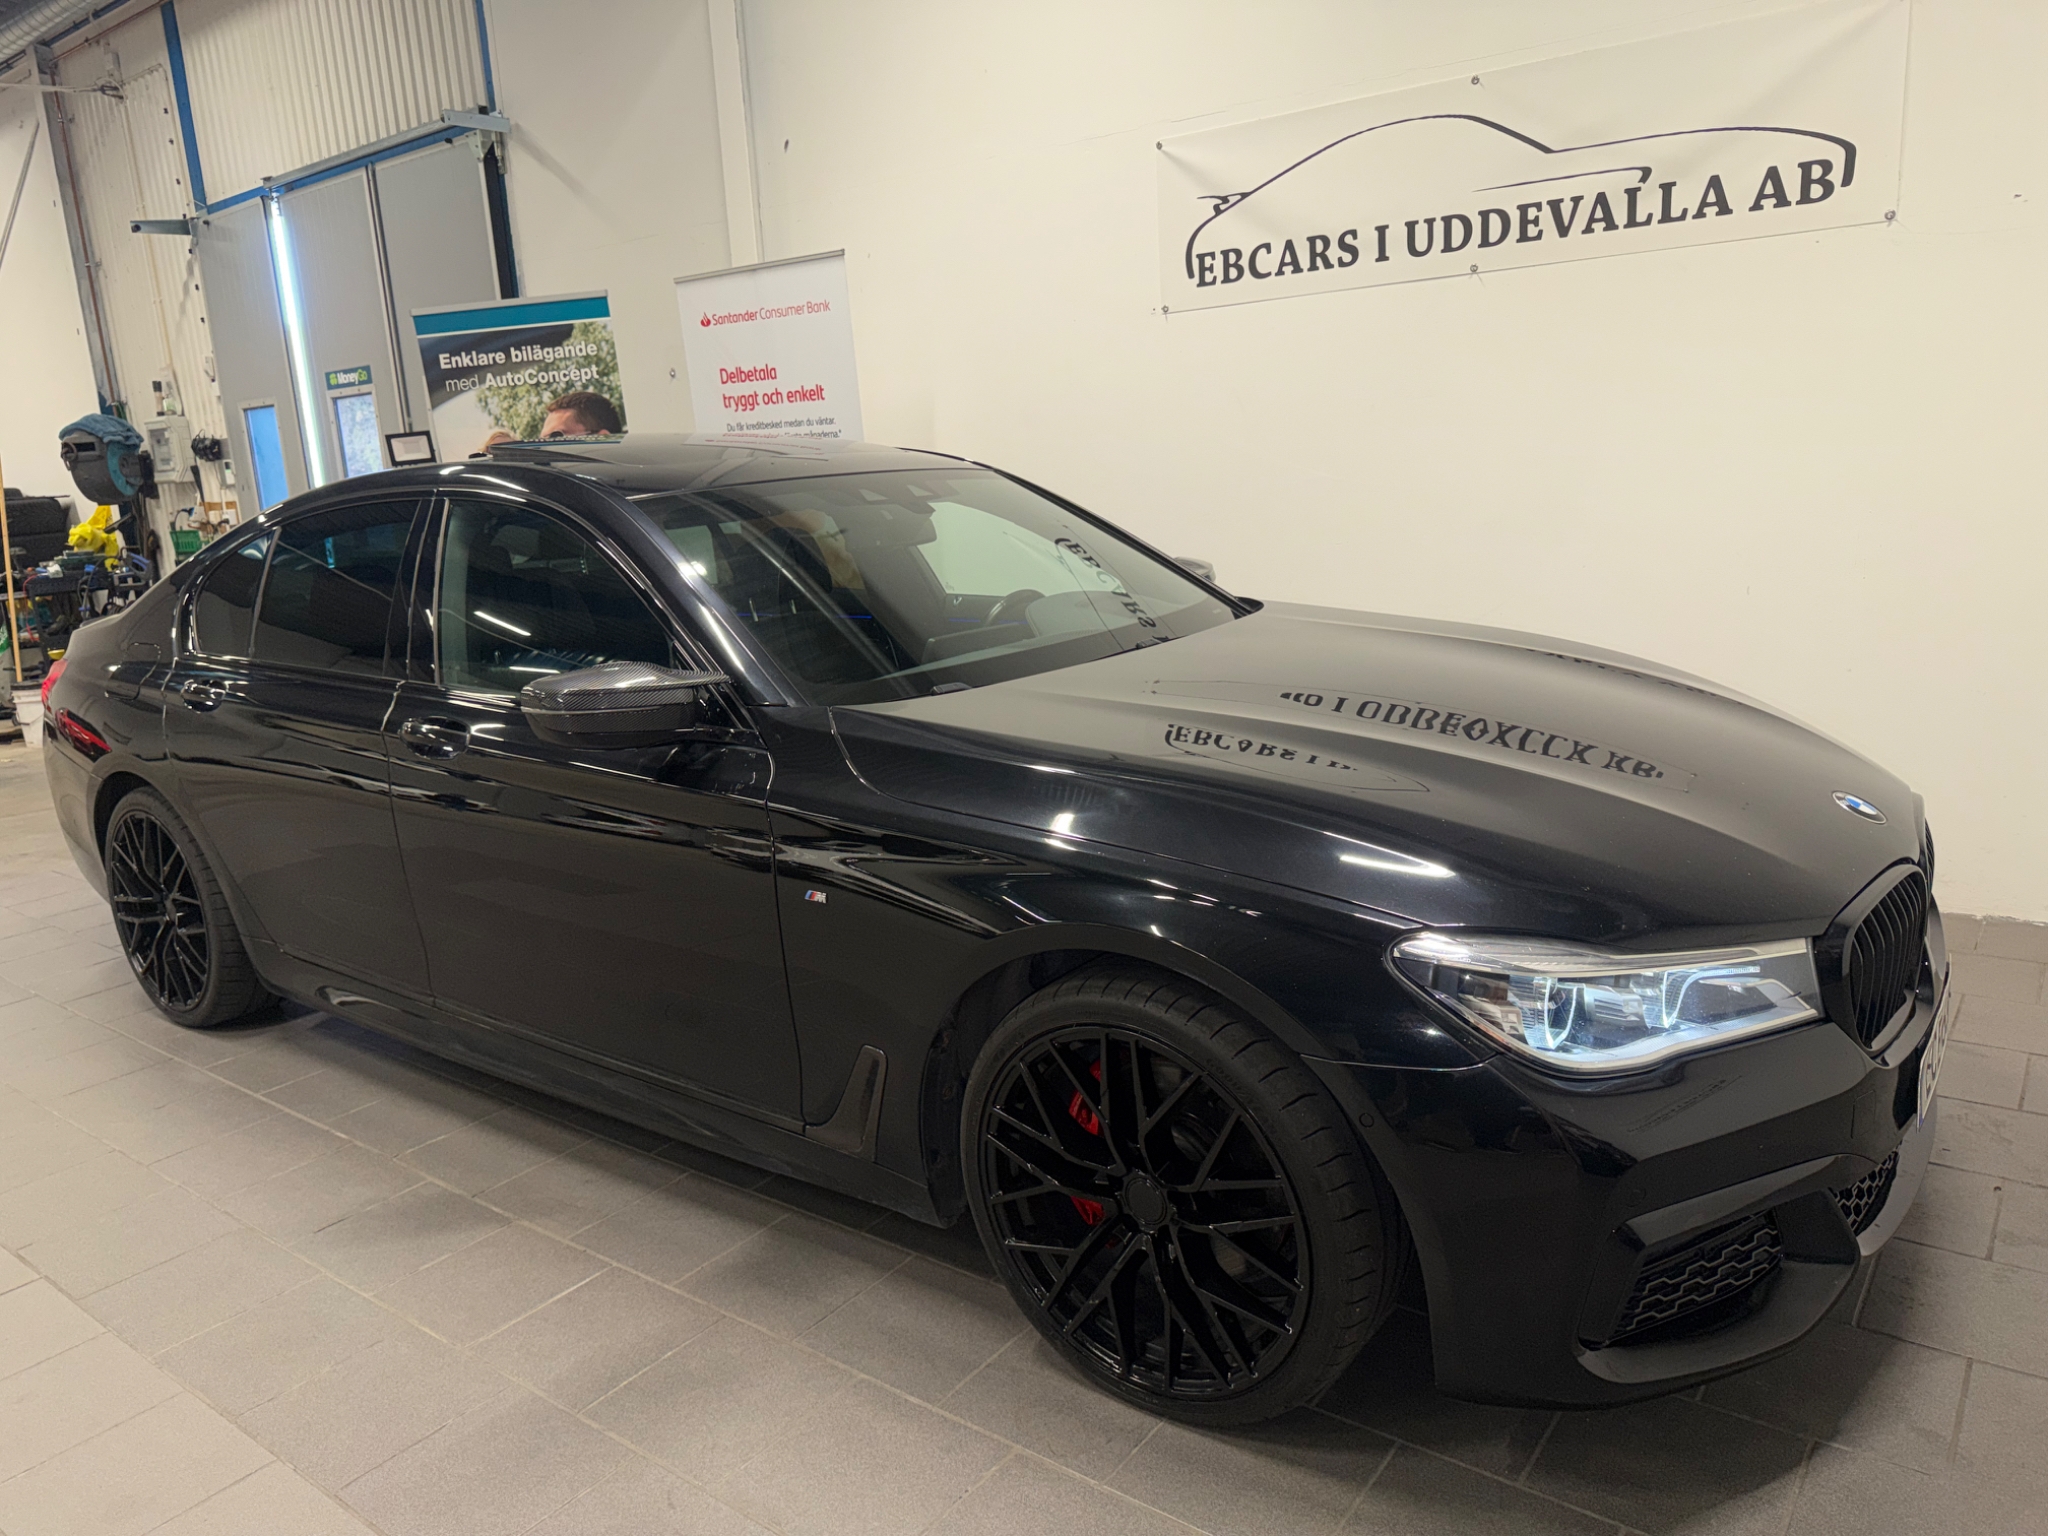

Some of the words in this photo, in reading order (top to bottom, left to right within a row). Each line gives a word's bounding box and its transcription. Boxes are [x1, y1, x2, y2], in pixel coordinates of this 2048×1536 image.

[1196, 229, 1360, 288] EBCARS
[1374, 224, 1390, 263] I
[1405, 174, 1733, 258] UDDEVALLA
[1748, 158, 1836, 213] AB
[711, 310, 758, 326] Santander
[760, 304, 805, 320] Consumer
[806, 299, 831, 314] Bank
[438, 350, 506, 369] Enklare
[510, 341, 598, 363] bilägande
[445, 374, 480, 392] med
[484, 364, 600, 389] AutoConcept
[719, 363, 777, 385] Delbetala
[722, 391, 760, 412] tryggt
[762, 388, 784, 405] och
[786, 384, 825, 403] enkelt
